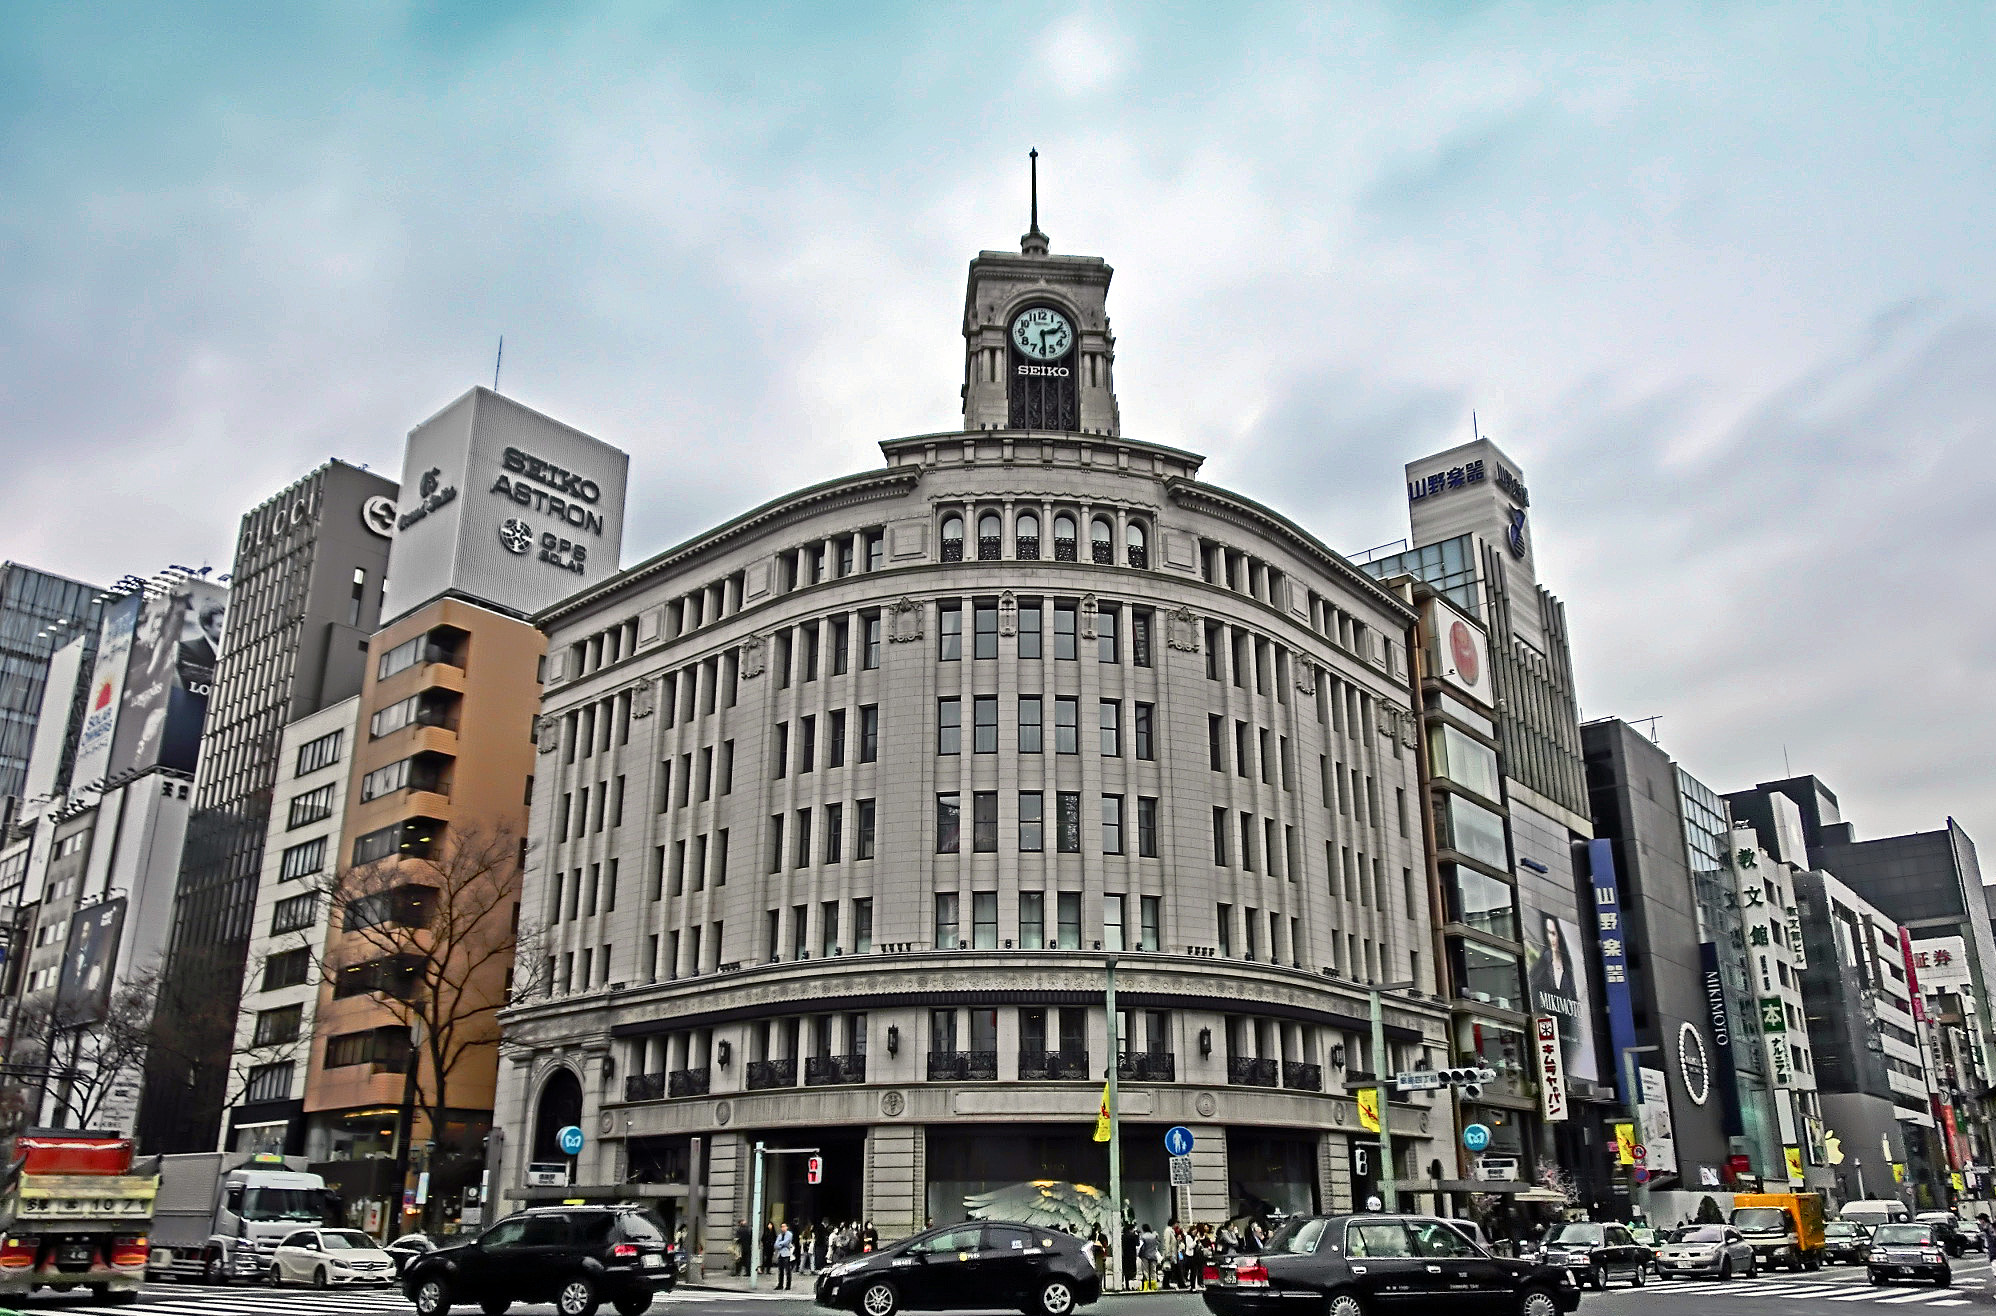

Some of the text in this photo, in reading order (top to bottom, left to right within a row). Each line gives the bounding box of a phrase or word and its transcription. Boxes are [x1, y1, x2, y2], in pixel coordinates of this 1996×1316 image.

[1029, 313, 1036, 321] 11
[1038, 312, 1047, 320] 12
[1051, 314, 1054, 322] 1
[1021, 320, 1030, 328] 10
[1057, 321, 1063, 329] 2
[1018, 328, 1025, 336] 9
[1060, 330, 1067, 338] 3
[1022, 337, 1029, 345] 8
[1056, 339, 1064, 347] 4
[1030, 344, 1037, 352] 7
[1049, 345, 1055, 353] 5
[1018, 365, 1069, 377] SEIKO
[502, 446, 600, 505] SEIKO
[1408, 459, 1485, 500] 山野楽器
[489, 474, 603, 536] ASTRON
[541, 531, 587, 562] GPS
[1737, 848, 1769, 948] 教文館
[1596, 888, 1625, 983] 山野楽器
[1539, 990, 1583, 1018] MIKIMOTO
[1705, 971, 1729, 1046] MIKIMOTO
[1763, 1003, 1782, 1027] 本
[1542, 1043, 1562, 1115] キムラヤのパン
